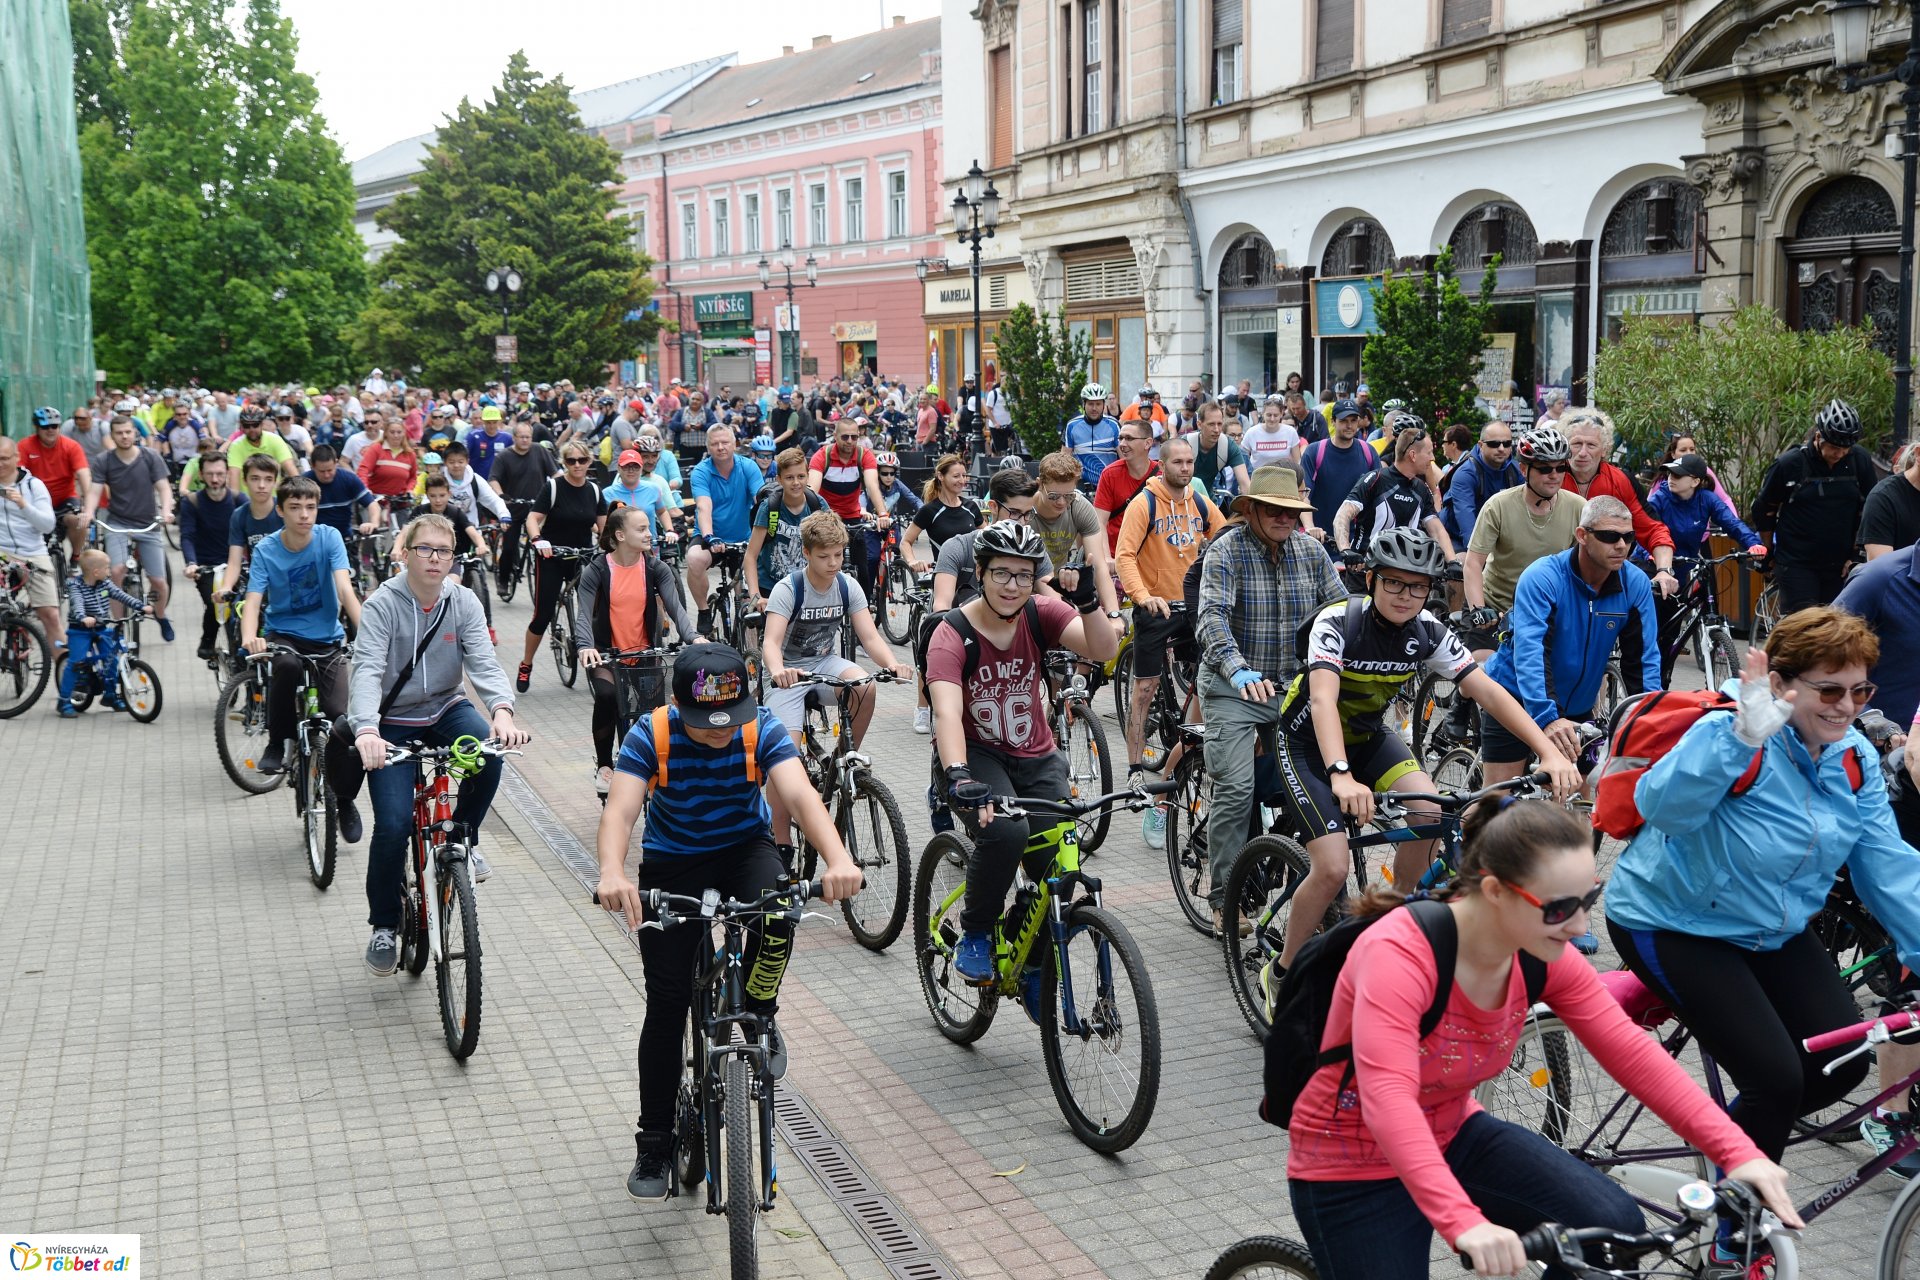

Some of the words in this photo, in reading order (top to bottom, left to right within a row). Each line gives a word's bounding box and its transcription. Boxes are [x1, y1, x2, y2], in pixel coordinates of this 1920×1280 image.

[698, 294, 745, 315] NYÍRSÉG
[940, 288, 972, 303] MARELLA
[972, 682, 1005, 699] East
[969, 691, 1033, 748] 96
[1278, 730, 1310, 805] CANNONDALE
[1814, 1171, 1860, 1211] FISCHER
